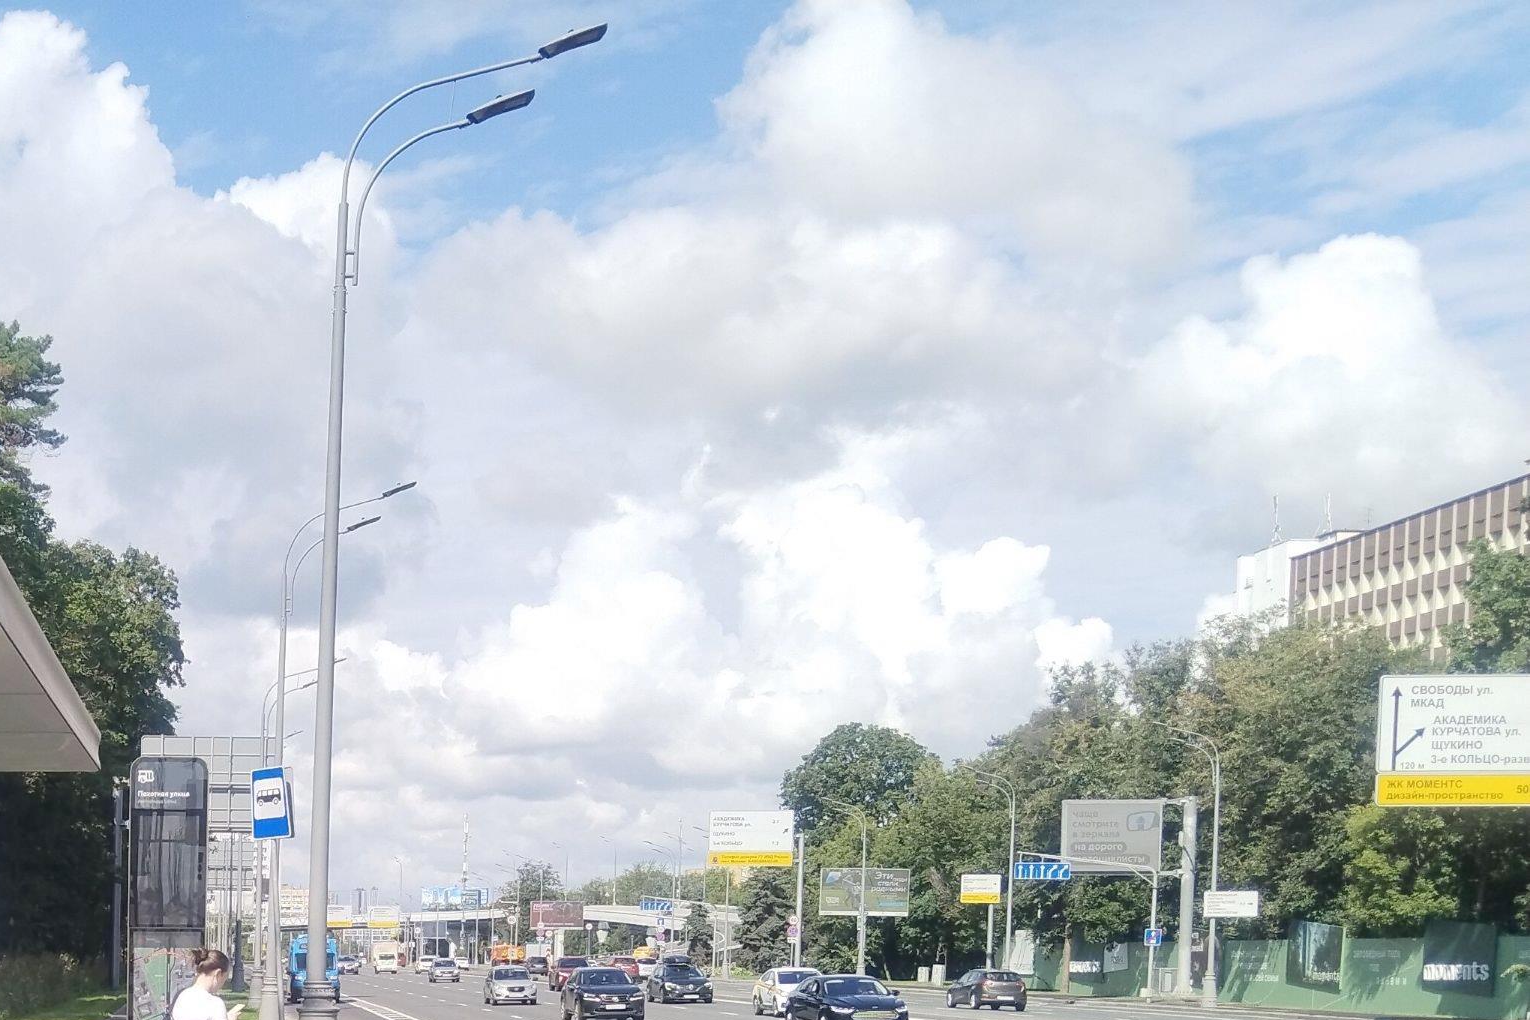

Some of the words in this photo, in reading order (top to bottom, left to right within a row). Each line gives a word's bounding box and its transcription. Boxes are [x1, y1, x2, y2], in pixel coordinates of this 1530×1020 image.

[1411, 686, 1473, 695] СВОБОДЫ
[1477, 687, 1493, 697] ул.
[1411, 698, 1444, 709] МКАД
[1433, 715, 1506, 725] АКАДЕМИКА
[1432, 727, 1501, 736] КУРЧАТОВА
[1505, 728, 1521, 737] ул.
[1431, 740, 1483, 750] ЩУКИНО
[1386, 780, 1403, 788] ЖК
[1407, 779, 1463, 788] МОМЕНТС
[1386, 792, 1503, 801] дизайн-пространство
